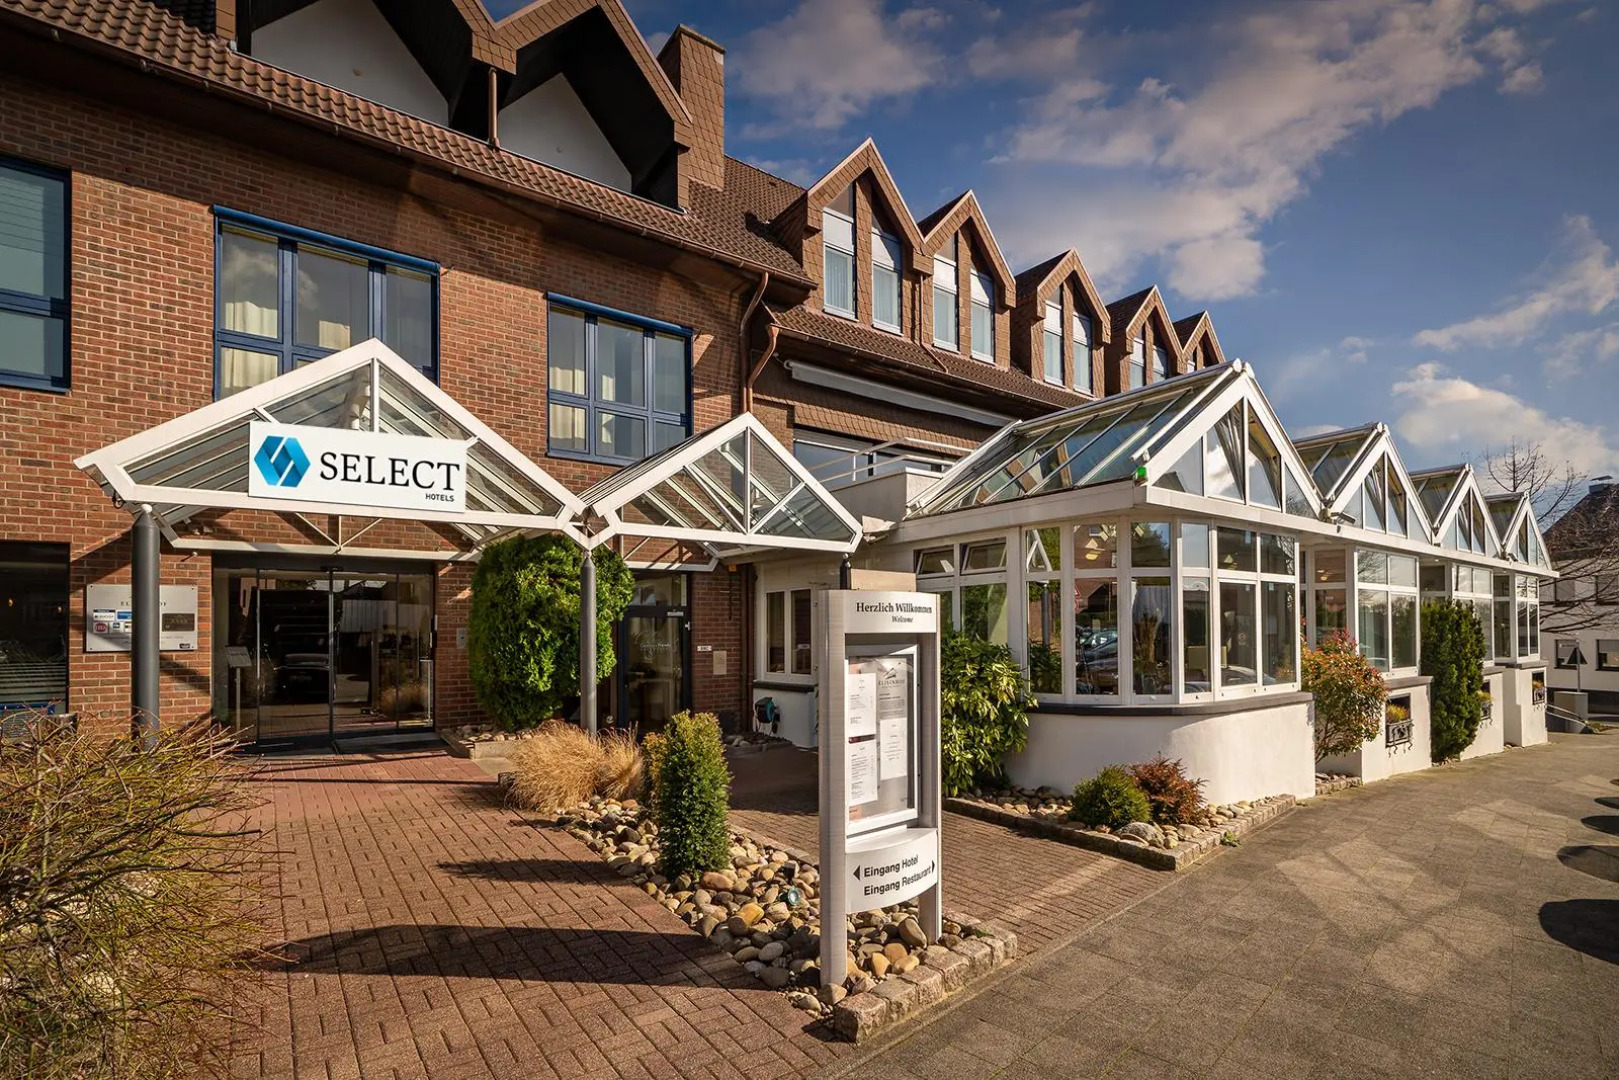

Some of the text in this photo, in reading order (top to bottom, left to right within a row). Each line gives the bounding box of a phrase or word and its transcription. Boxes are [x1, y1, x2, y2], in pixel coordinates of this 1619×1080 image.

[320, 452, 460, 491] SELECT
[425, 493, 455, 502] HOTELS
[856, 602, 932, 614] Herzlich Willkommen
[864, 855, 919, 877] Eingang Hotel
[864, 866, 931, 896] Eingang Restaurant
